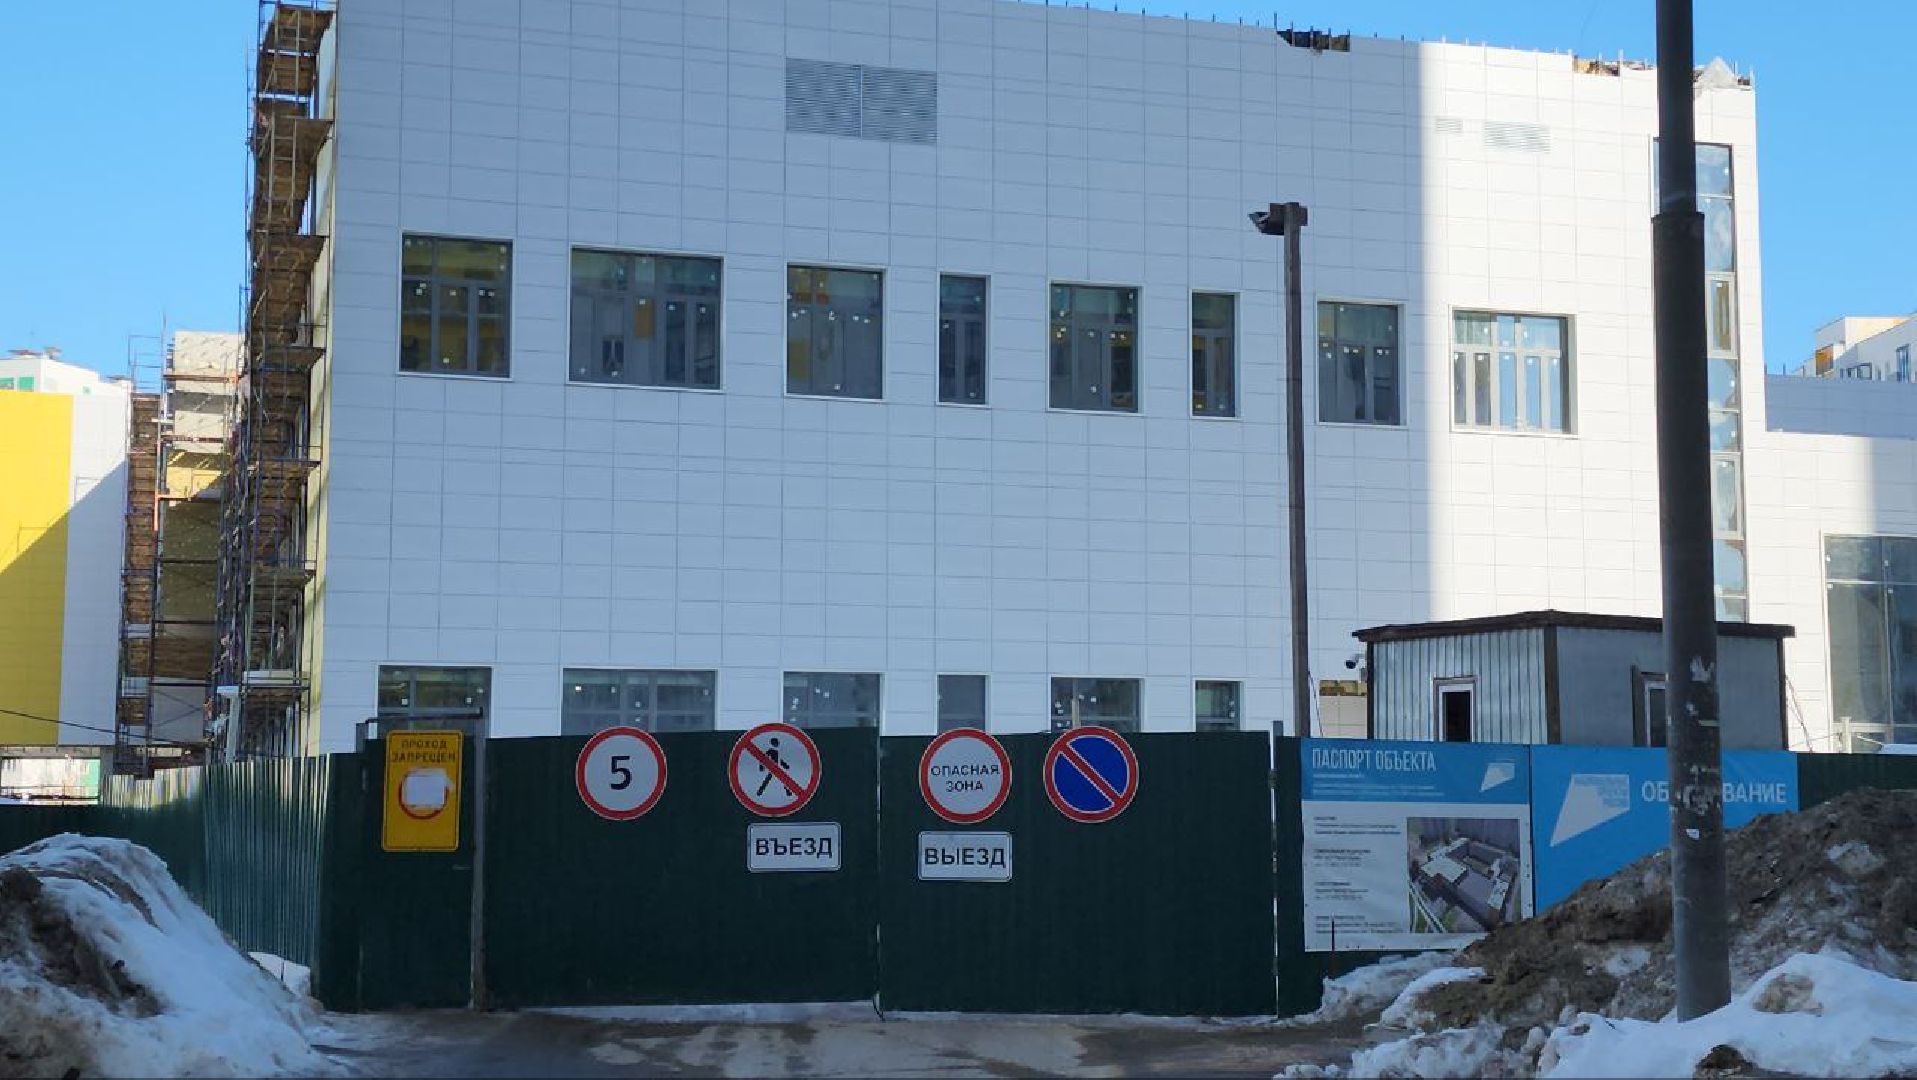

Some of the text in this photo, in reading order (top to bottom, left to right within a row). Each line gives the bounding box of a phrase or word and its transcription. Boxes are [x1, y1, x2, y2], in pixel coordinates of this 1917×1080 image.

[401, 740, 447, 749] ПРОХОД
[1312, 747, 1437, 772] ПАСПОРТ ОБЪЕКТА
[610, 755, 632, 790] 5
[930, 764, 1000, 776] ОПАСНАЯ
[945, 780, 984, 792] ЗОНА
[1641, 780, 1786, 803] ОБВАНИЕ
[755, 837, 832, 858] ВЪЕЗД
[924, 848, 1006, 868] ВЫЕЗД
